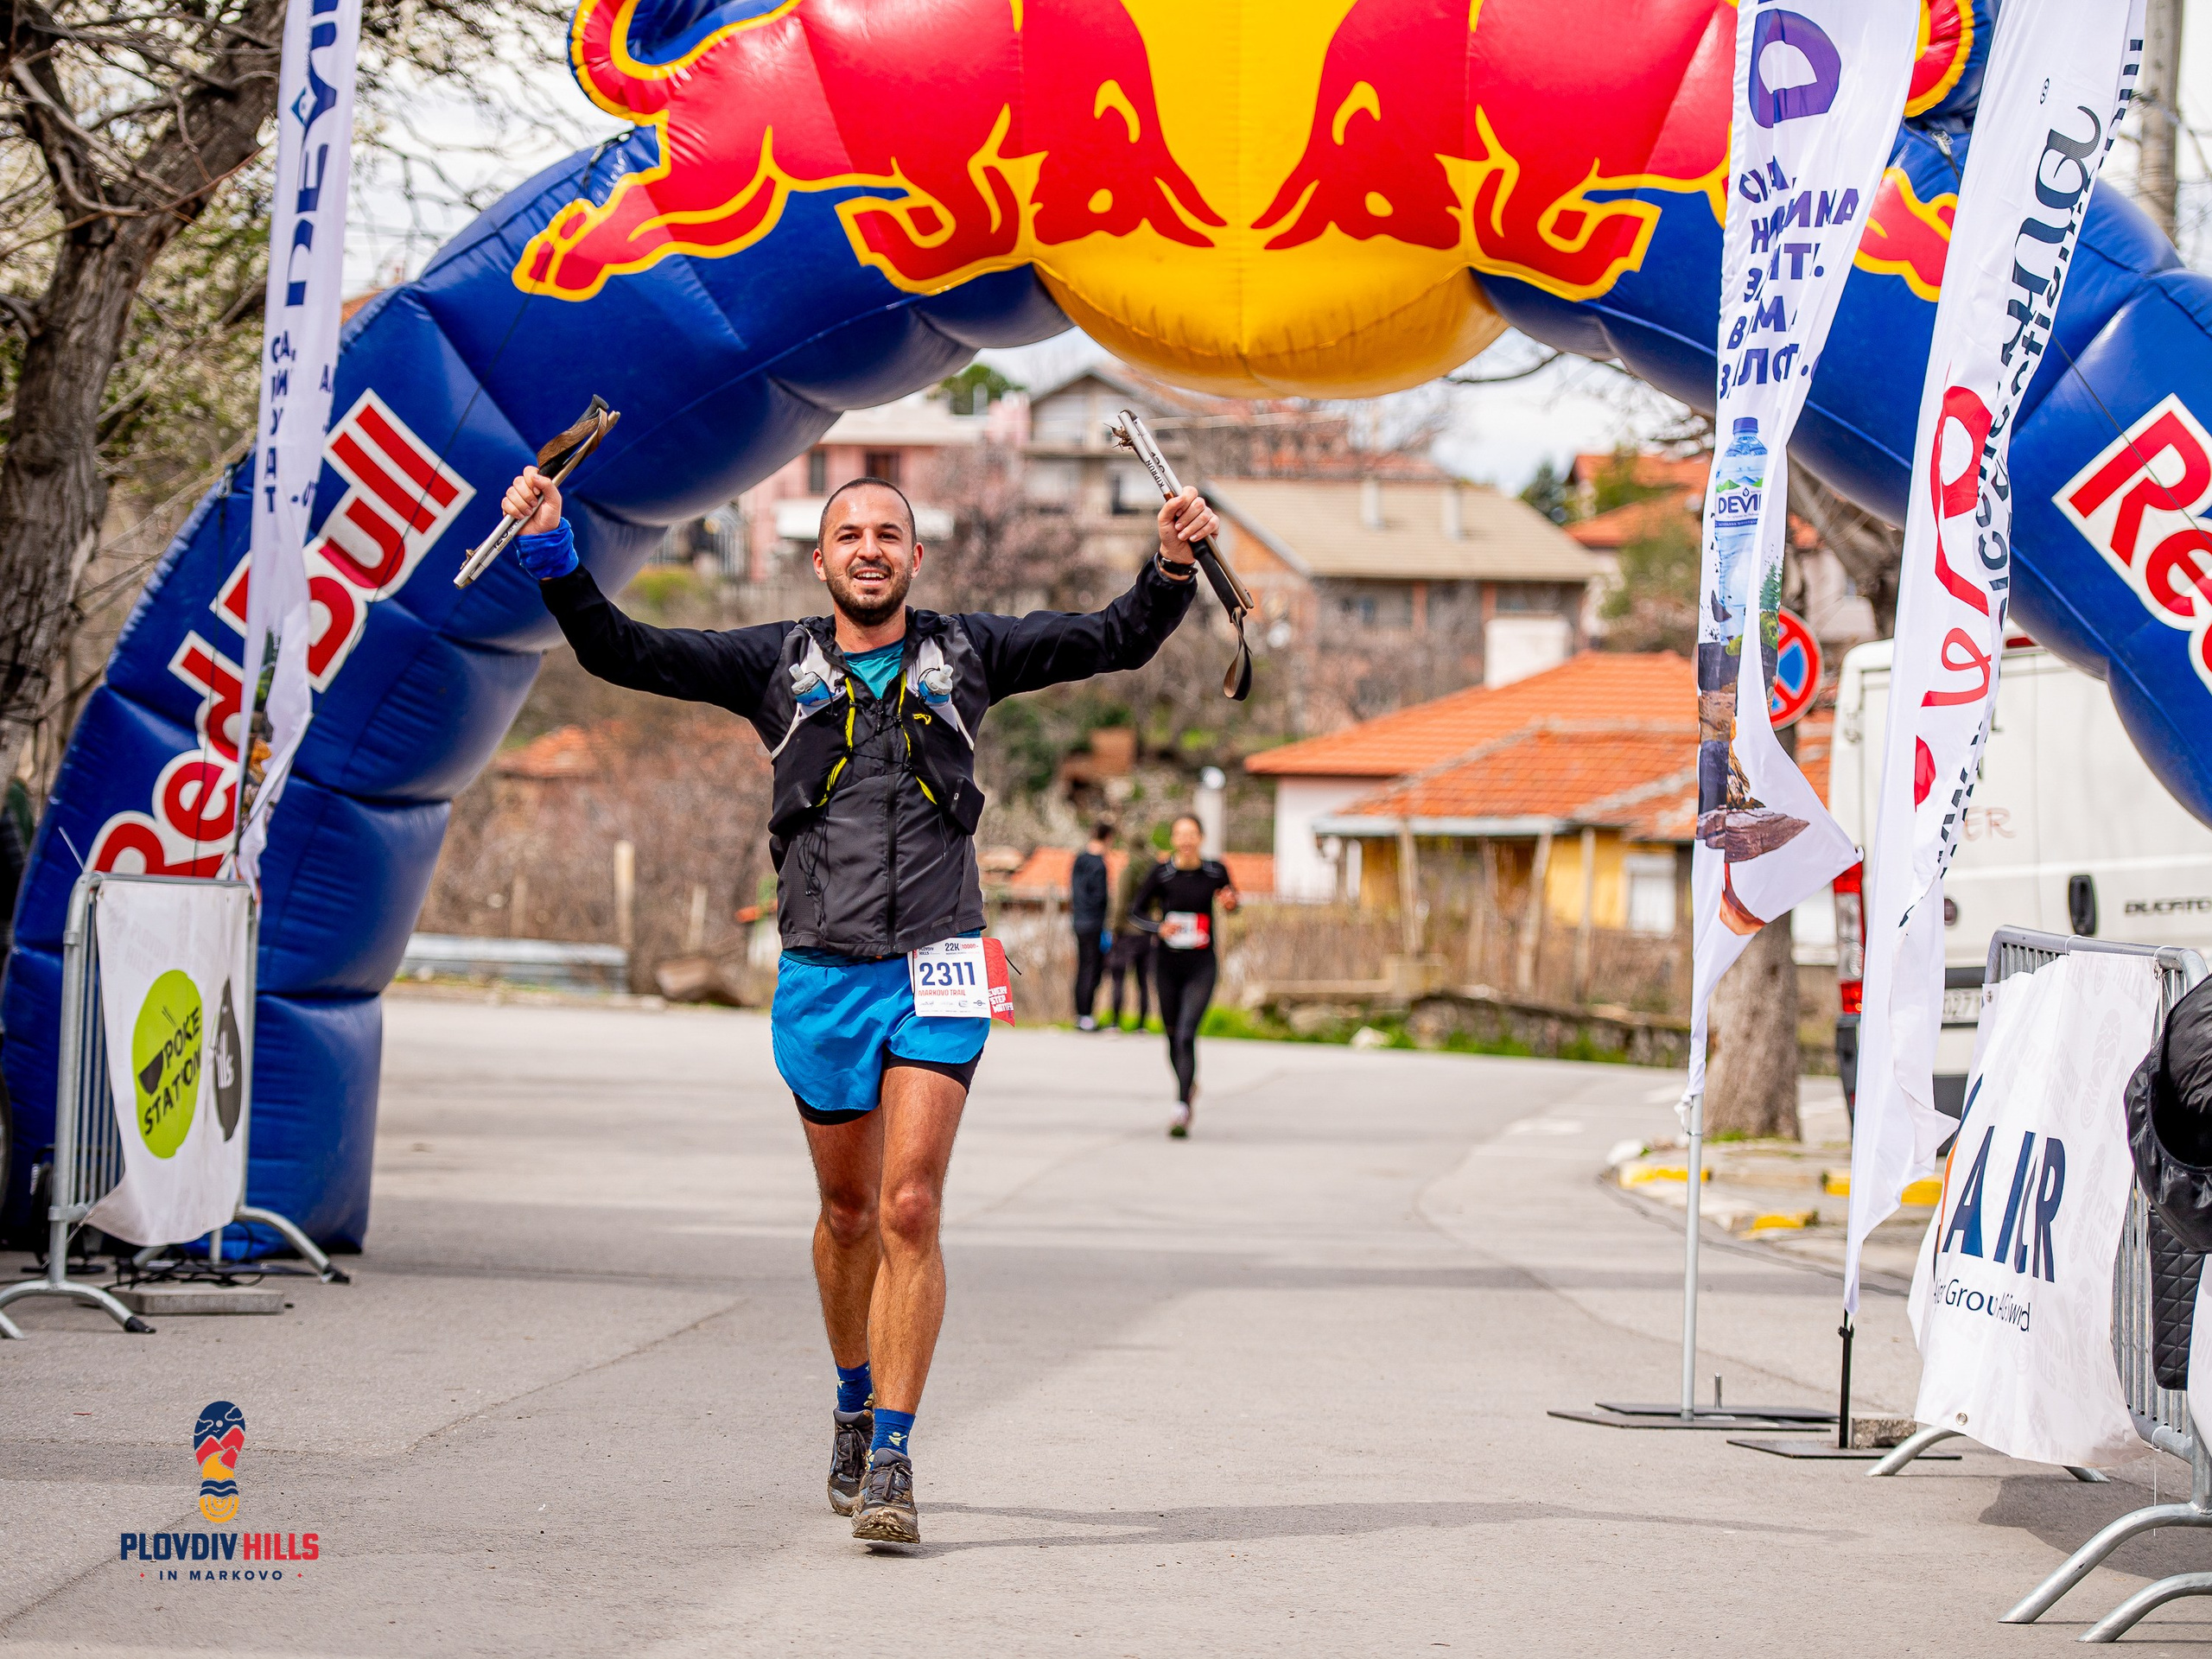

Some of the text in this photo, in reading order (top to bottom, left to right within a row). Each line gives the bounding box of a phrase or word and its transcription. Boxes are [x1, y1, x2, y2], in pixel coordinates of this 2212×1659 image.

[1145, 459, 1165, 488] KIPRUN
[2063, 406, 2212, 677] Re
[944, 942, 960, 951] 22K
[919, 962, 976, 986] 2311
[989, 995, 1007, 1005] STEP
[164, 1006, 201, 1071] POKE
